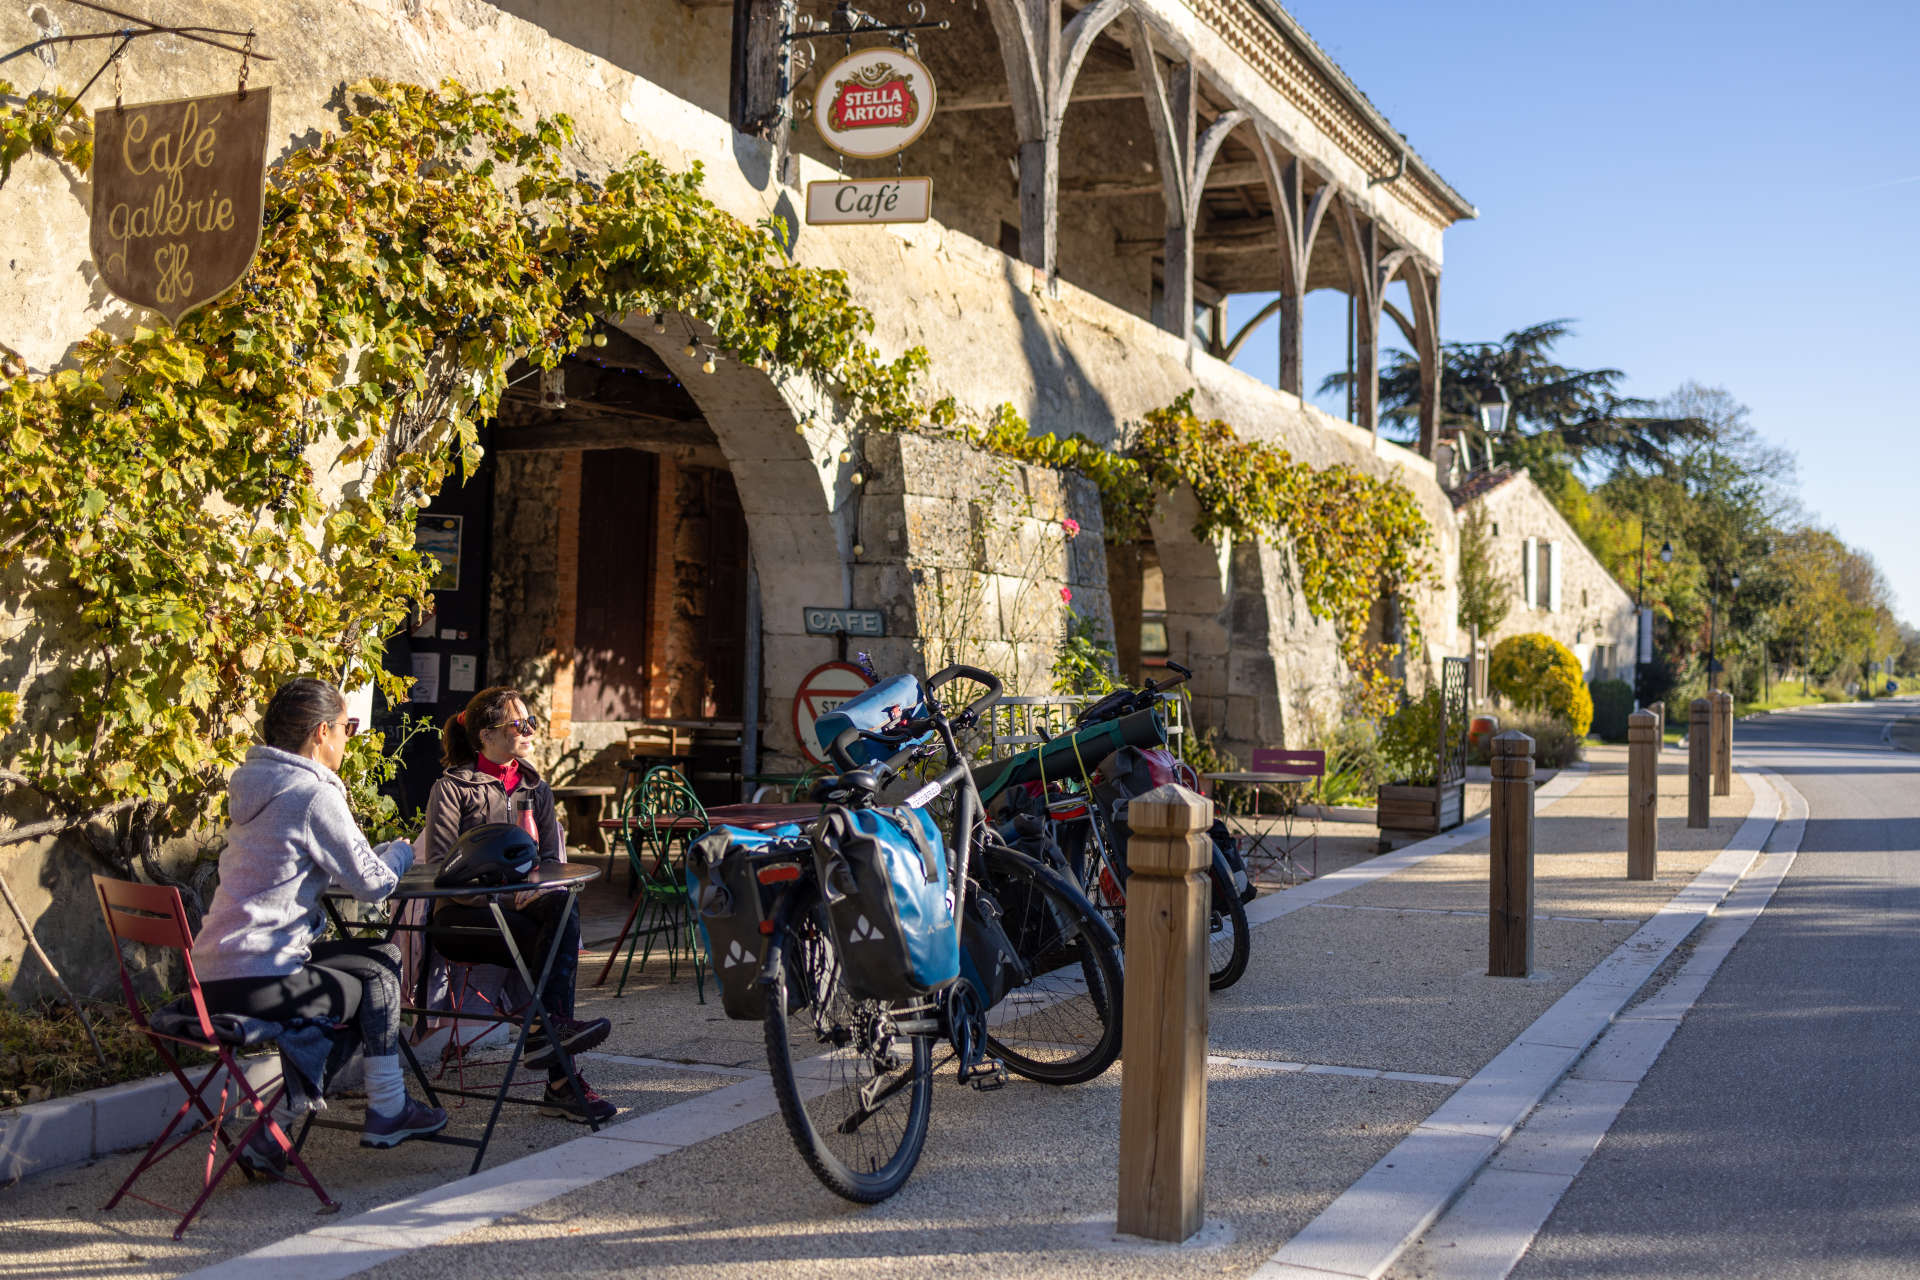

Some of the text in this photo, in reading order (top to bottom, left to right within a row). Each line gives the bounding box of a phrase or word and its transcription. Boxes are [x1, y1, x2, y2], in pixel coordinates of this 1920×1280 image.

[845, 89, 903, 107] STELLA
[843, 104, 903, 122] ARTOIS
[123, 101, 222, 204] Café
[835, 184, 900, 218] Café
[107, 184, 235, 277] galerie
[809, 611, 879, 632] CAFE
[821, 700, 845, 714] ST
